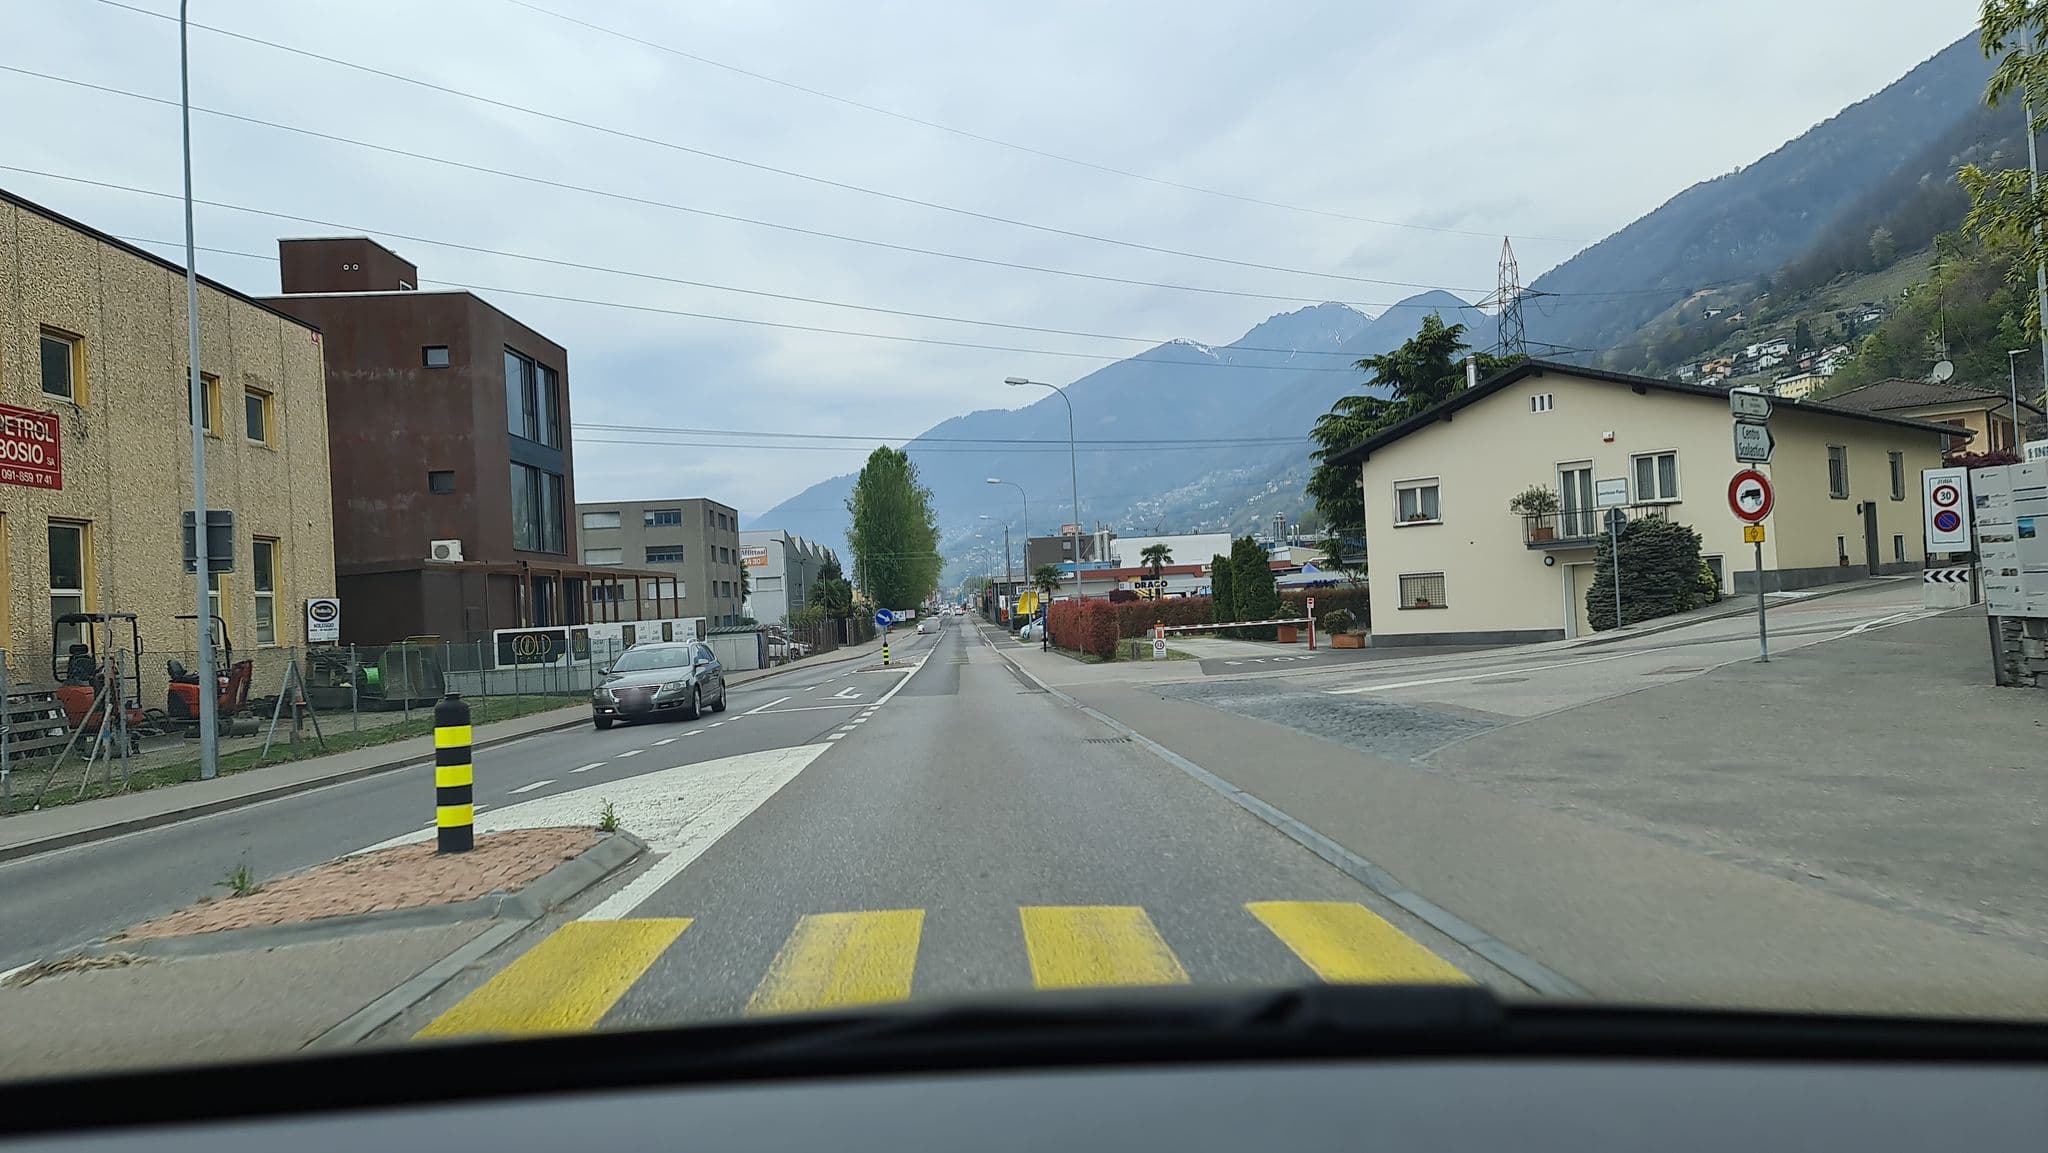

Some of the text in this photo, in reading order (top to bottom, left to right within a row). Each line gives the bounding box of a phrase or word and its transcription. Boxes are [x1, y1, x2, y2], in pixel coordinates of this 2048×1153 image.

[0, 439, 55, 466] BOSIO SA
[1940, 492, 1951, 500] 30
[1134, 581, 1168, 589] DRAGO
